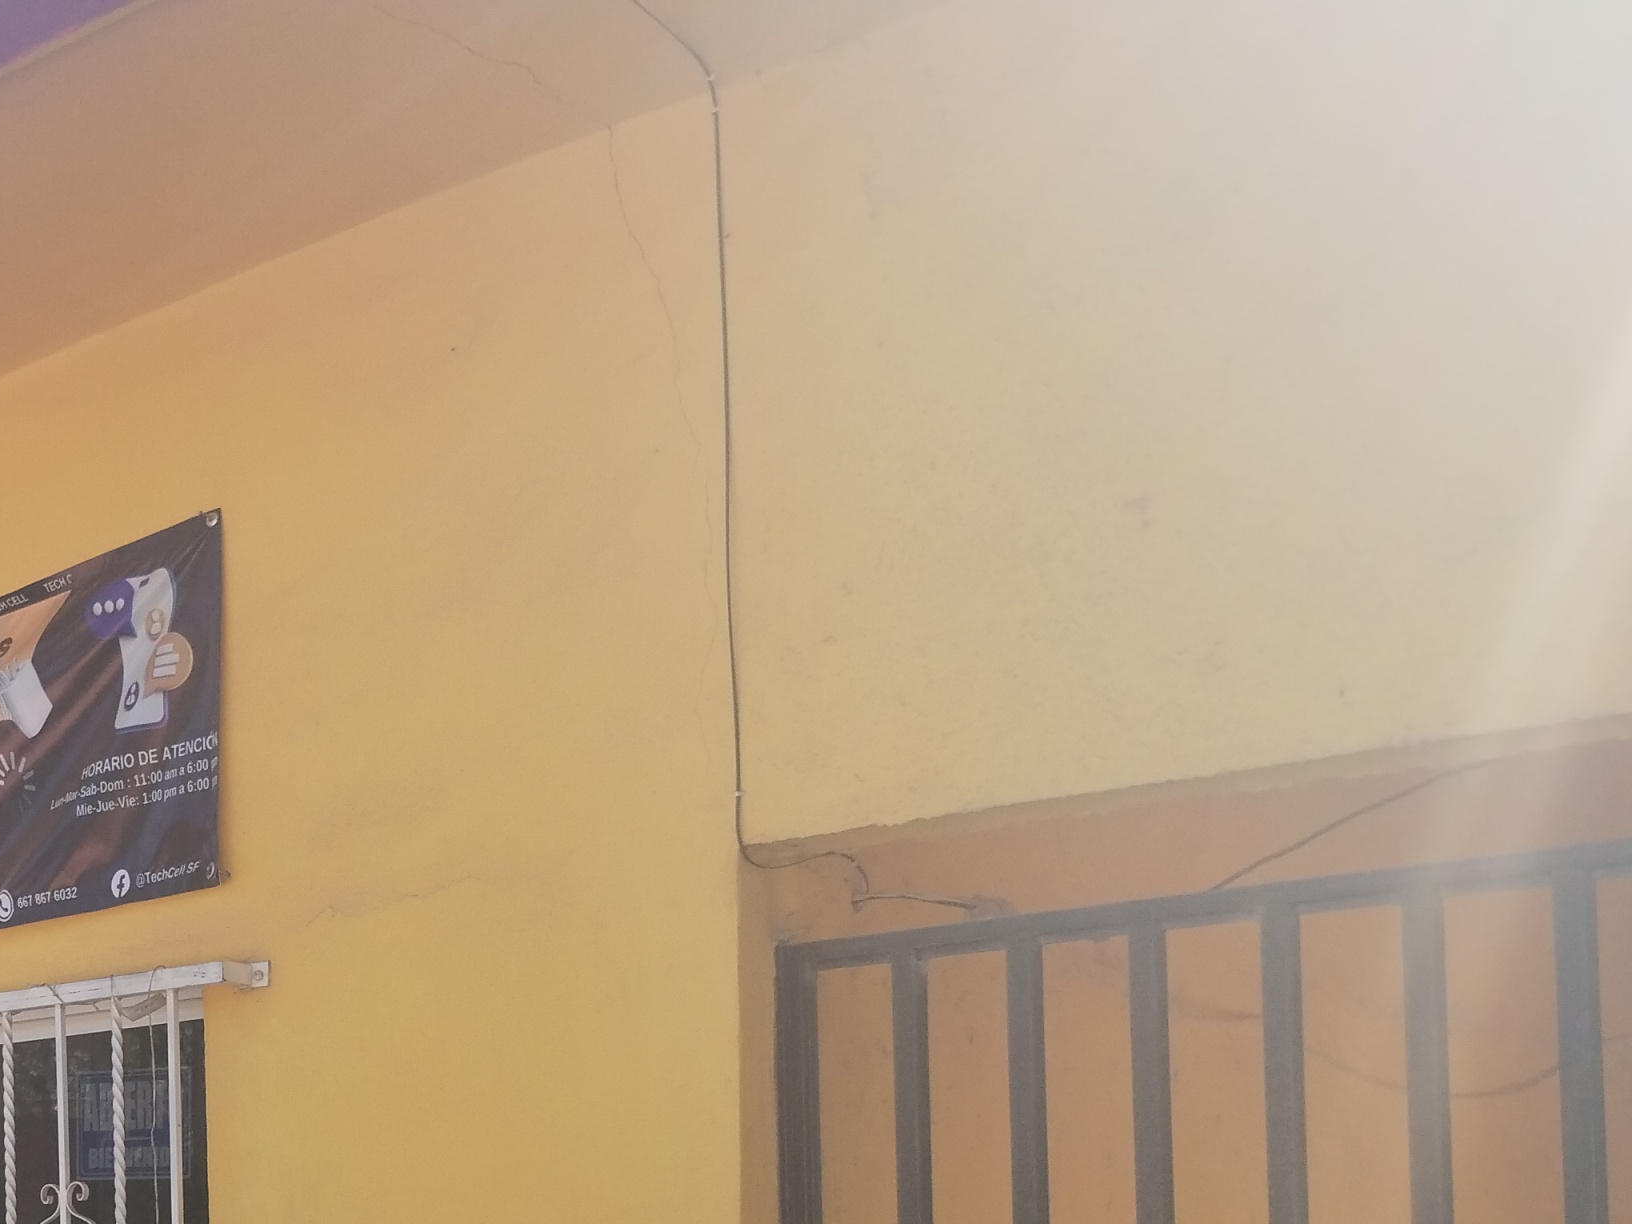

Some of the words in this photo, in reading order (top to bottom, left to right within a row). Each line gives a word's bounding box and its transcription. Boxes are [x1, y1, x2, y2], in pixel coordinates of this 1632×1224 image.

[7, 594, 29, 608] CELL
[43, 577, 67, 593] TECH
[80, 753, 135, 780] HORARIO
[138, 748, 159, 766] DE
[133, 770, 163, 787] 11:00
[164, 767, 178, 781] am
[179, 766, 185, 776] a
[186, 758, 209, 774] 6:00
[142, 789, 163, 805] 1:00
[163, 784, 178, 801] pm
[178, 783, 185, 795] a
[187, 777, 210, 793] 6:00
[17, 894, 34, 909] 667
[53, 886, 78, 902] 6032
